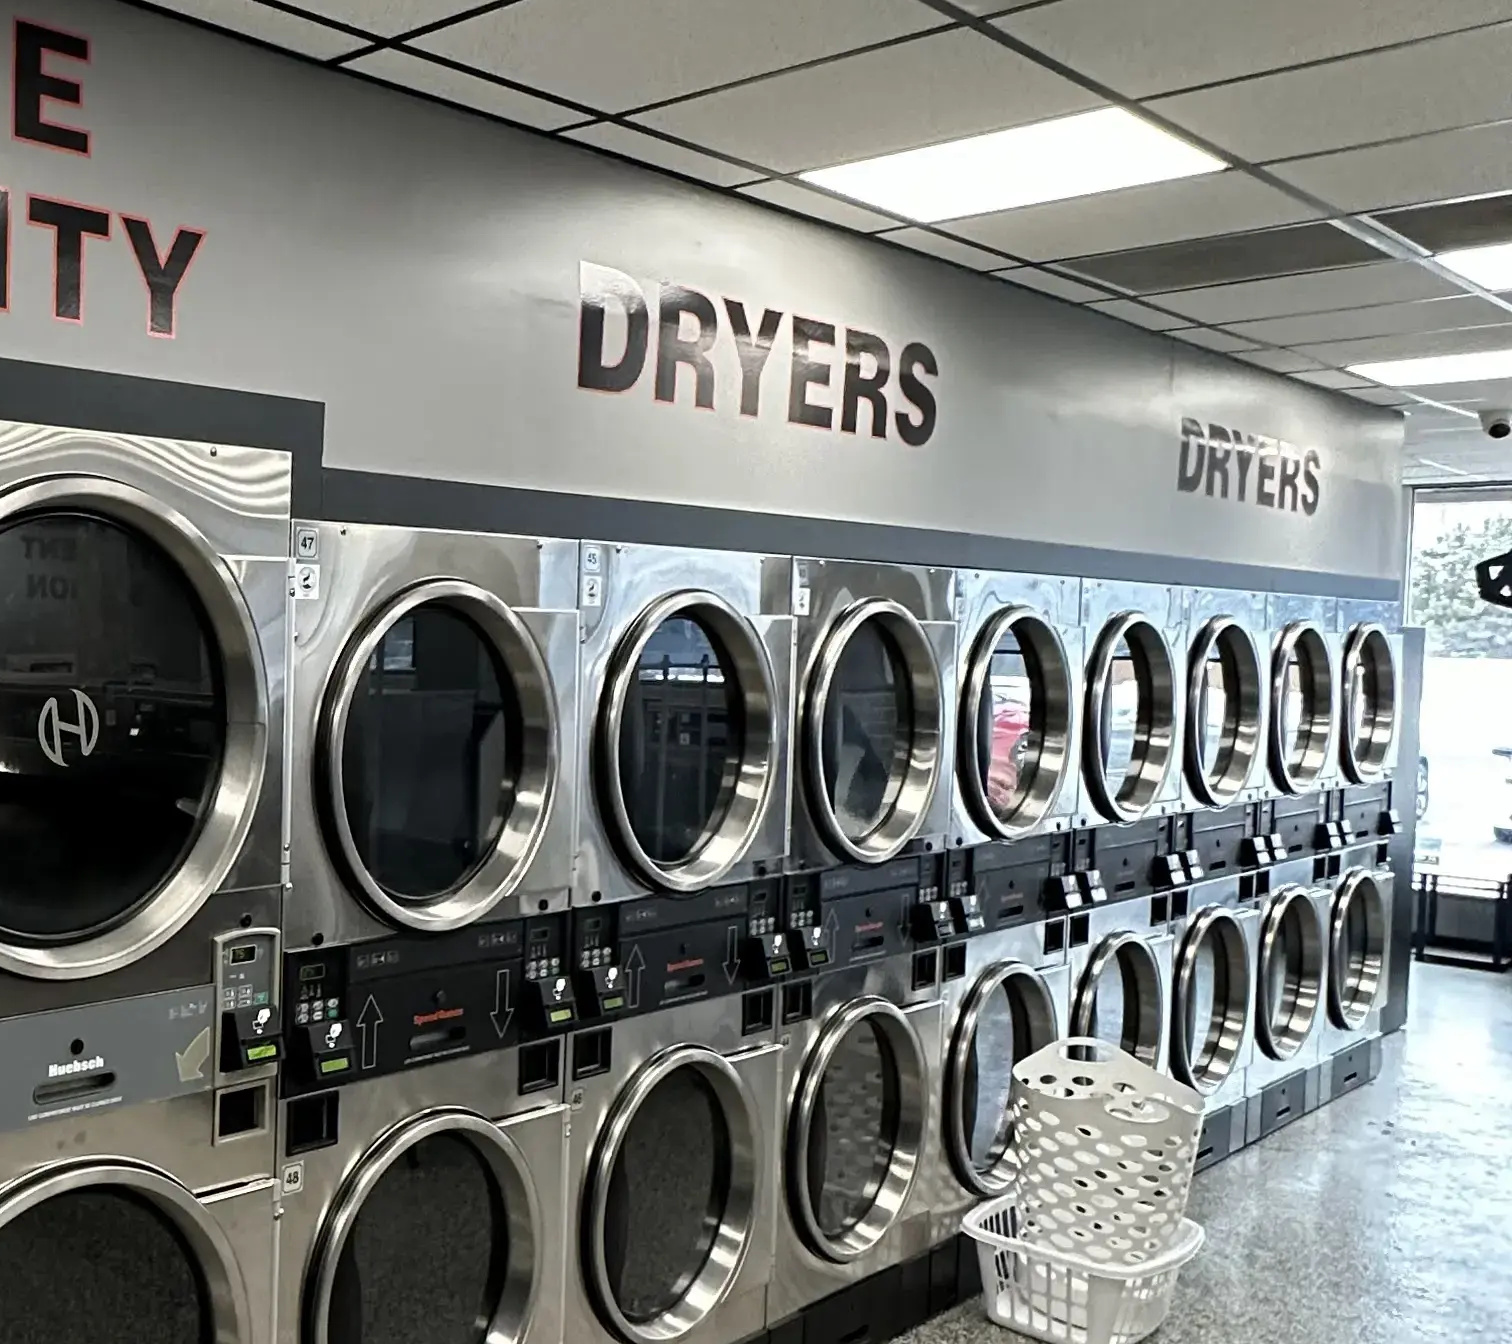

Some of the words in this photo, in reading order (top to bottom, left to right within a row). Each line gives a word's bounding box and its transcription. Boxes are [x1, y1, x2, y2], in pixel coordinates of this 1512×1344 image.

[577, 259, 939, 448] DRYERS
[1177, 416, 1322, 517] DRYERS
[300, 536, 315, 550] 47
[587, 552, 598, 565] 45
[48, 1055, 105, 1077] Huebsch
[285, 1170, 301, 1185] 48
